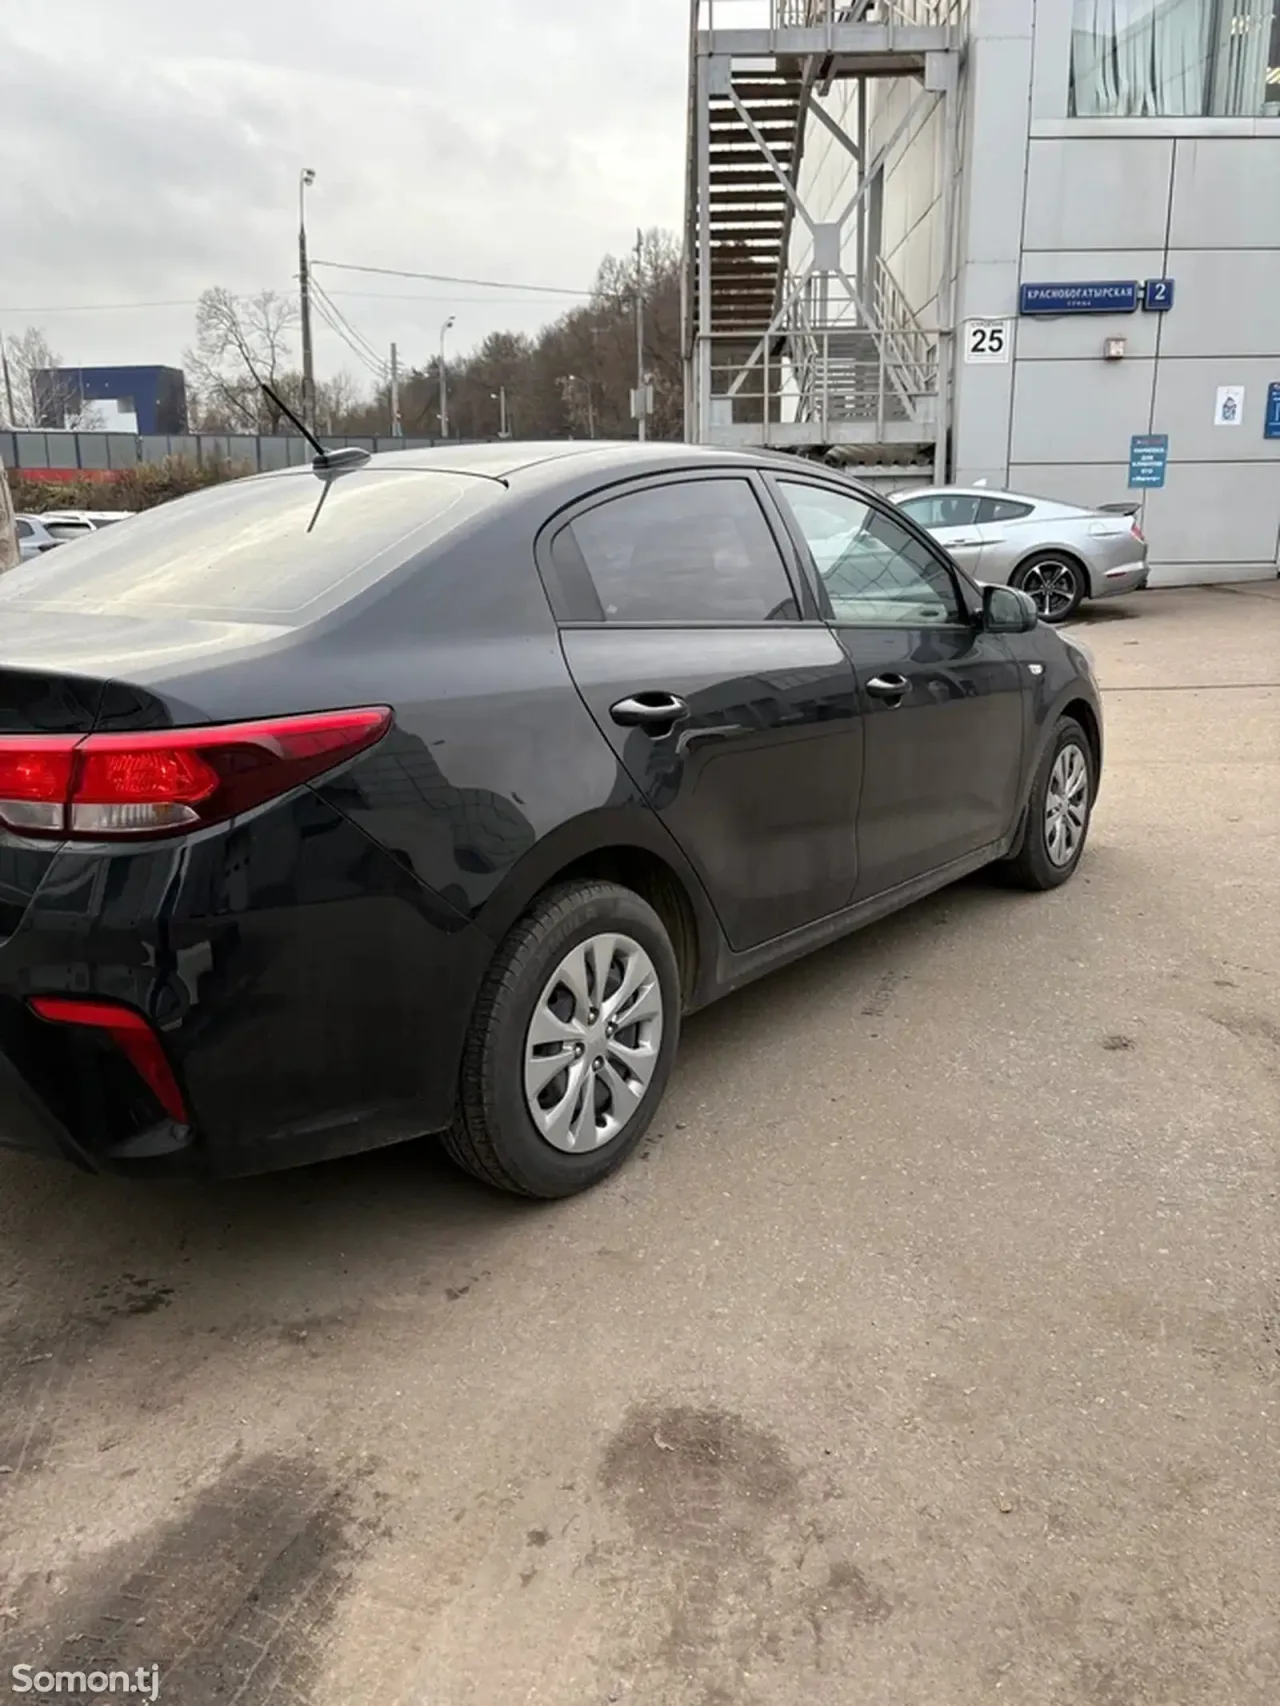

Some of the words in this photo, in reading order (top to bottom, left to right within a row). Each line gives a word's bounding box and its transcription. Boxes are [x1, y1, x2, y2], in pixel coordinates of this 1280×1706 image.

[1027, 287, 1133, 300] КРАСНОБОГАТЫРСКАЯ
[1155, 283, 1166, 300] 2
[971, 328, 1003, 353] 25
